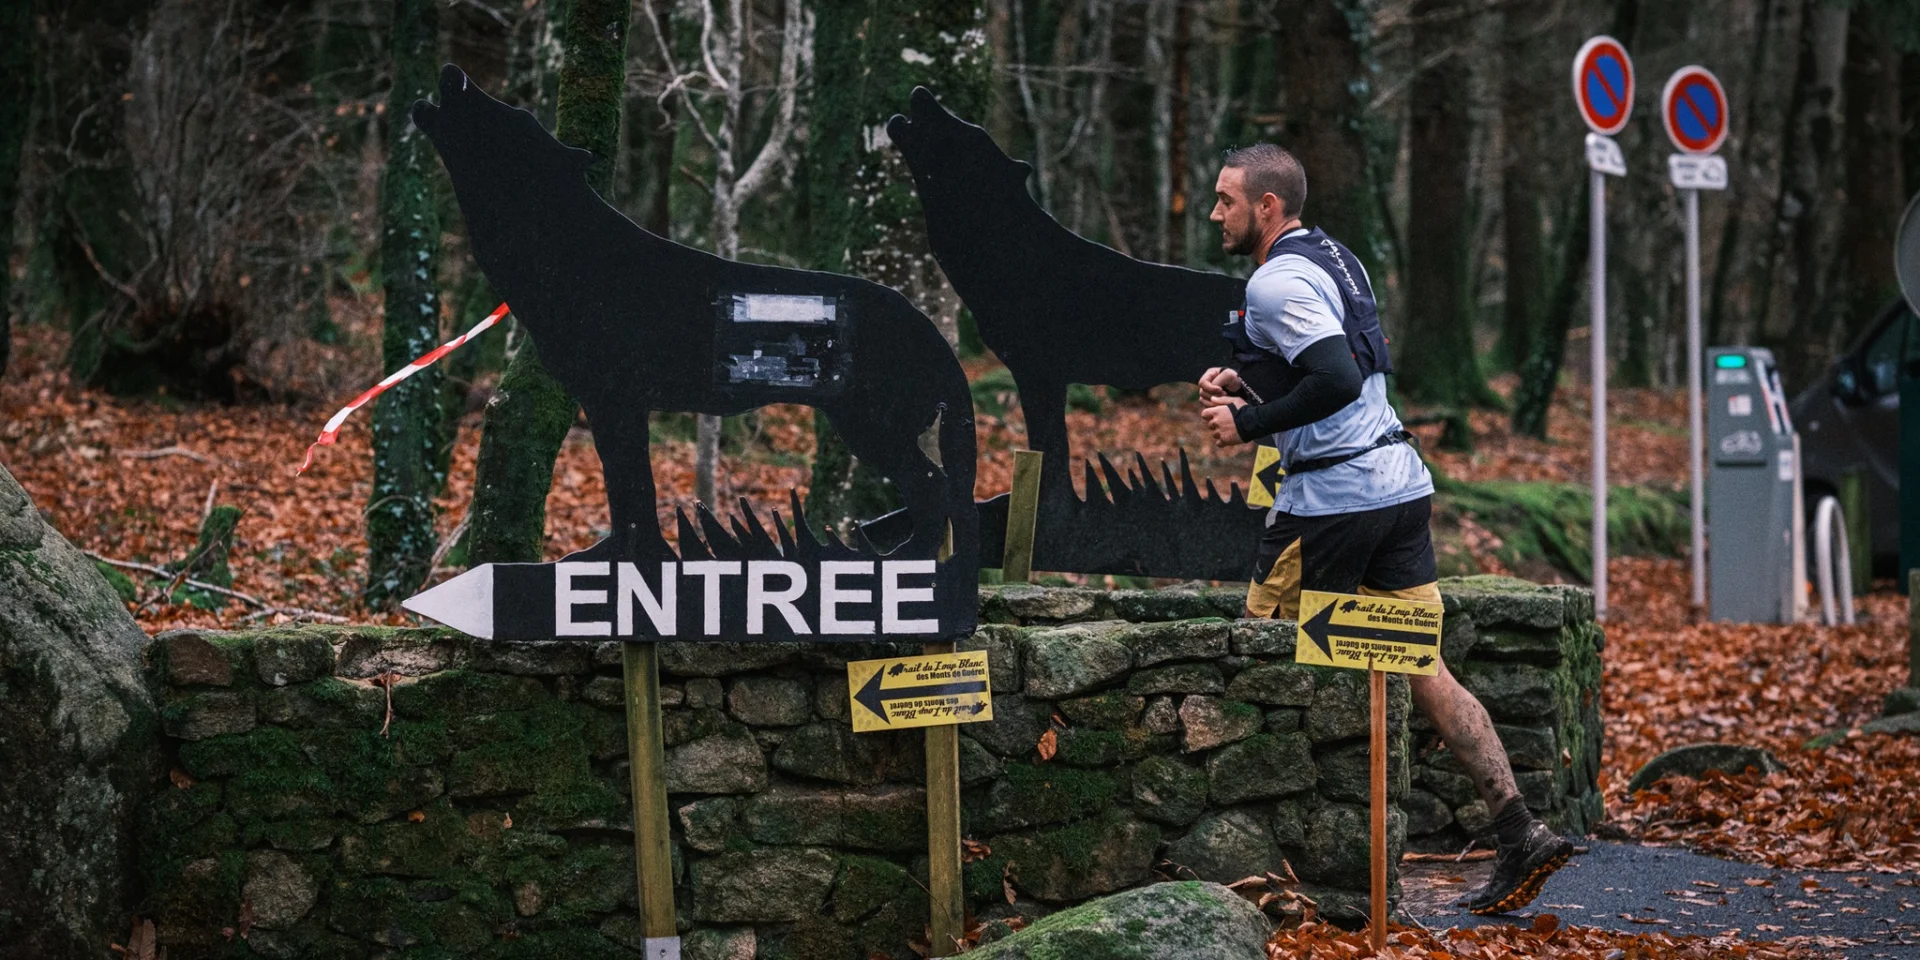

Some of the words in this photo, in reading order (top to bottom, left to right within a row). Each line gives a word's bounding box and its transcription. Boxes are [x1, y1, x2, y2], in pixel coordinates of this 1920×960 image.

[555, 560, 939, 635] ENTREE
[1376, 604, 1386, 614] du
[1387, 604, 1411, 616] Loup
[1412, 607, 1438, 619] Blanc
[1368, 614, 1380, 622] des
[1382, 616, 1403, 624] Monts
[1404, 618, 1413, 626] de
[1415, 618, 1438, 628] Guéret
[1371, 644, 1392, 653] Monts
[922, 662, 933, 672] du
[935, 661, 957, 672] Loup
[958, 659, 983, 668] Blanc
[916, 672, 928, 680] des
[930, 671, 951, 679] Monts
[952, 670, 961, 678] de
[962, 668, 985, 677] Guéret
